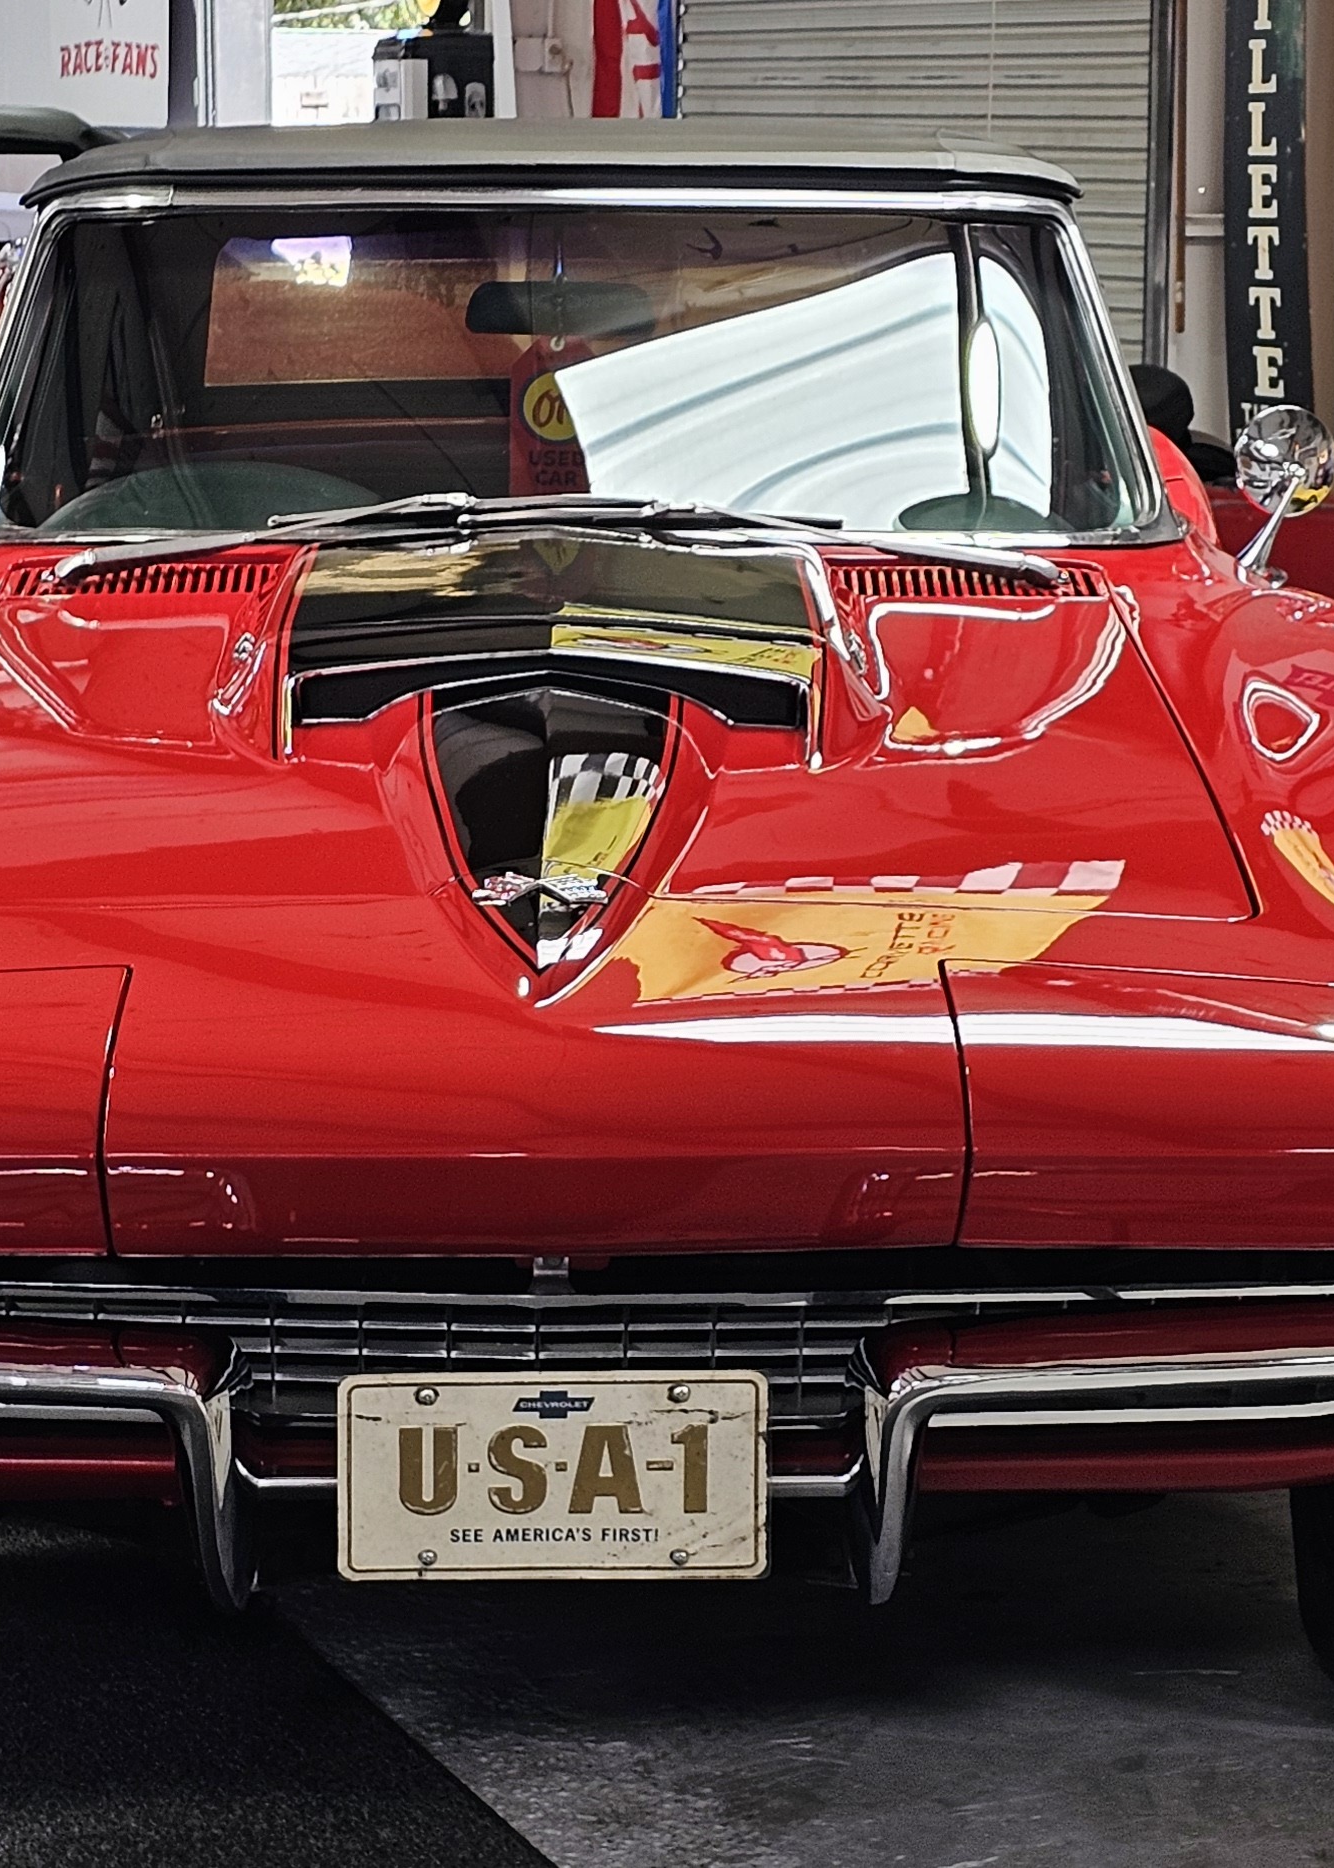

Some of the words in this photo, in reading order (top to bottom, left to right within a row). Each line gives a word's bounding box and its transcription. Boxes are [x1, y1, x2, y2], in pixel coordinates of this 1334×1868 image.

[60, 38, 103, 78] RACE
[110, 40, 159, 79] FANS
[518, 1400, 590, 1409] CHEVROLET
[450, 1528, 483, 1543] SEE
[493, 1527, 592, 1543] AMERICA'S
[601, 1527, 659, 1542] FIRST!
